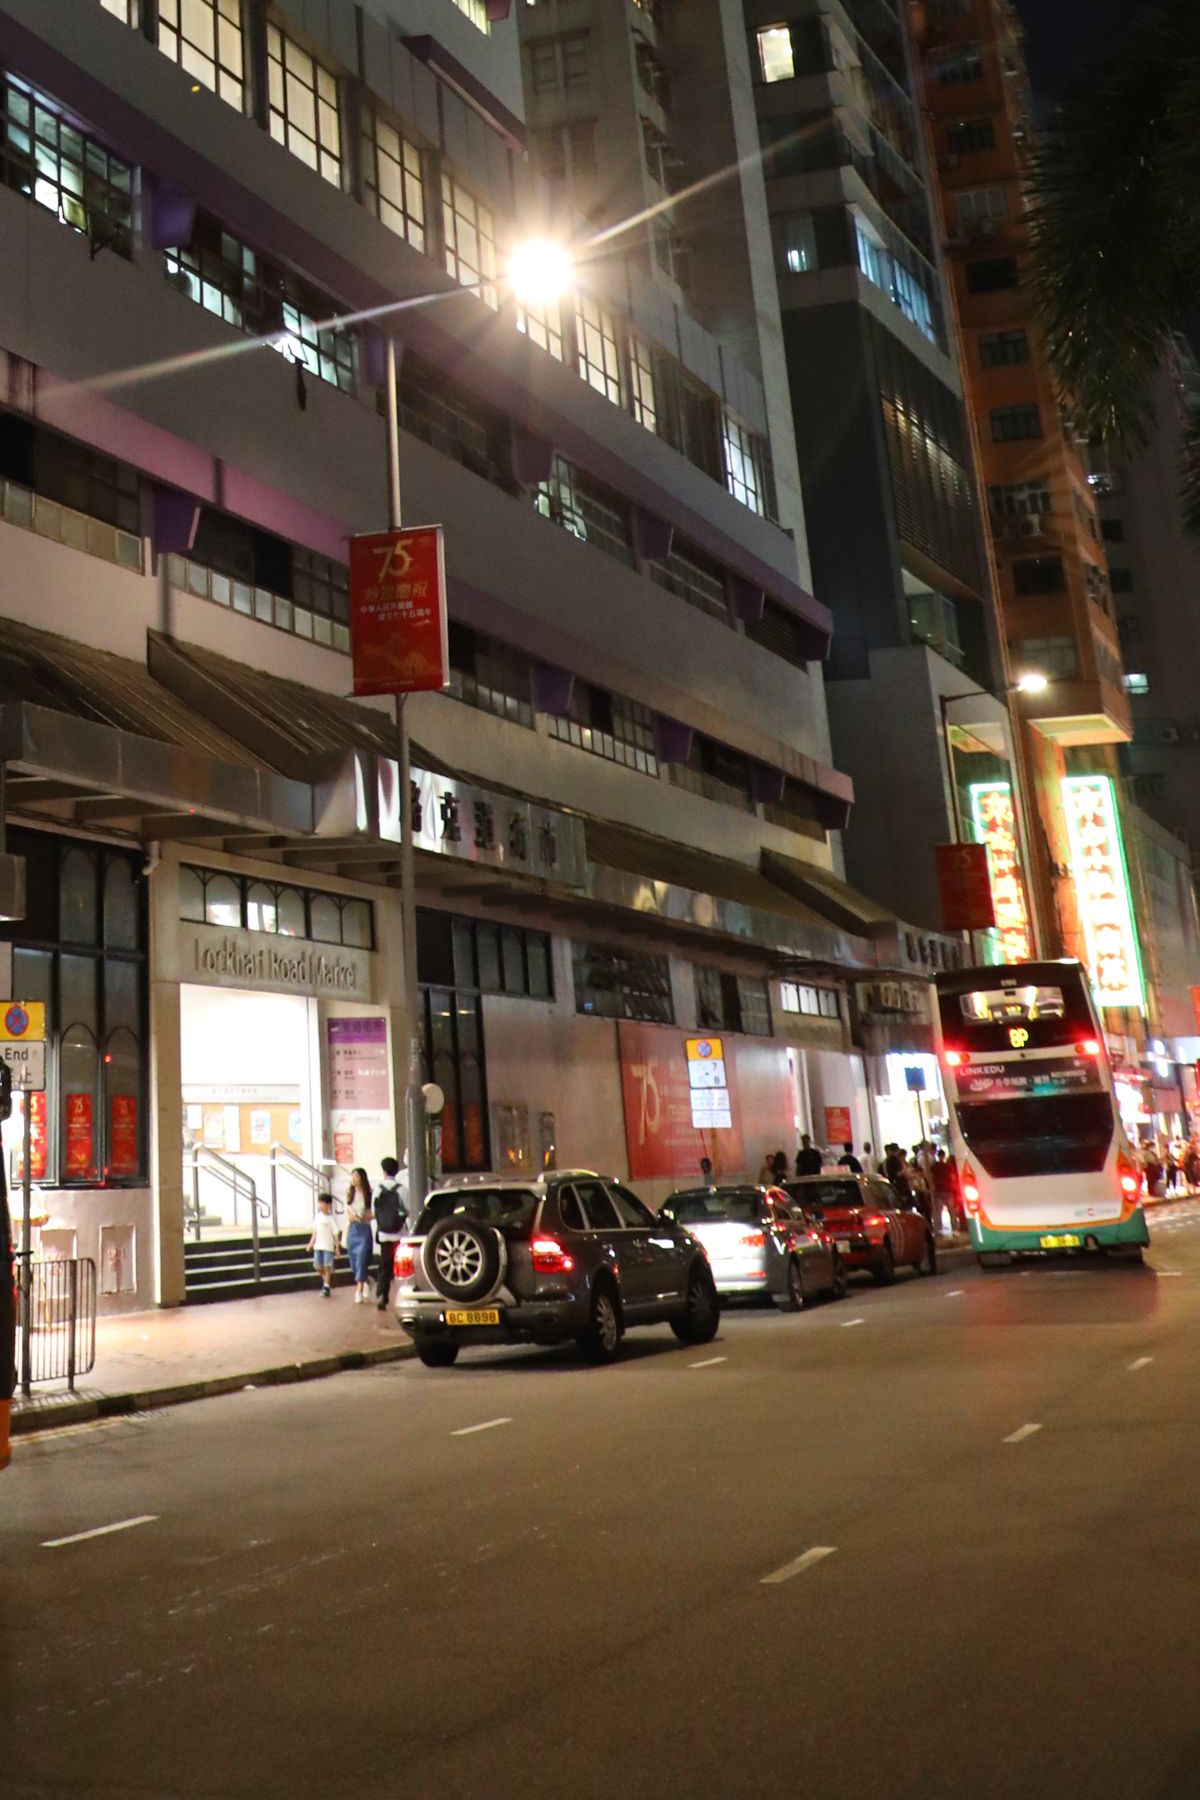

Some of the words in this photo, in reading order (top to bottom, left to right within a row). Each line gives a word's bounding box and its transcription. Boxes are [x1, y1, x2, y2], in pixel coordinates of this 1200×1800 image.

[372, 538, 414, 584] 75
[194, 935, 264, 977] Lockhart
[267, 947, 307, 982] Road
[308, 951, 357, 989] Market
[4, 1047, 29, 1061] End
